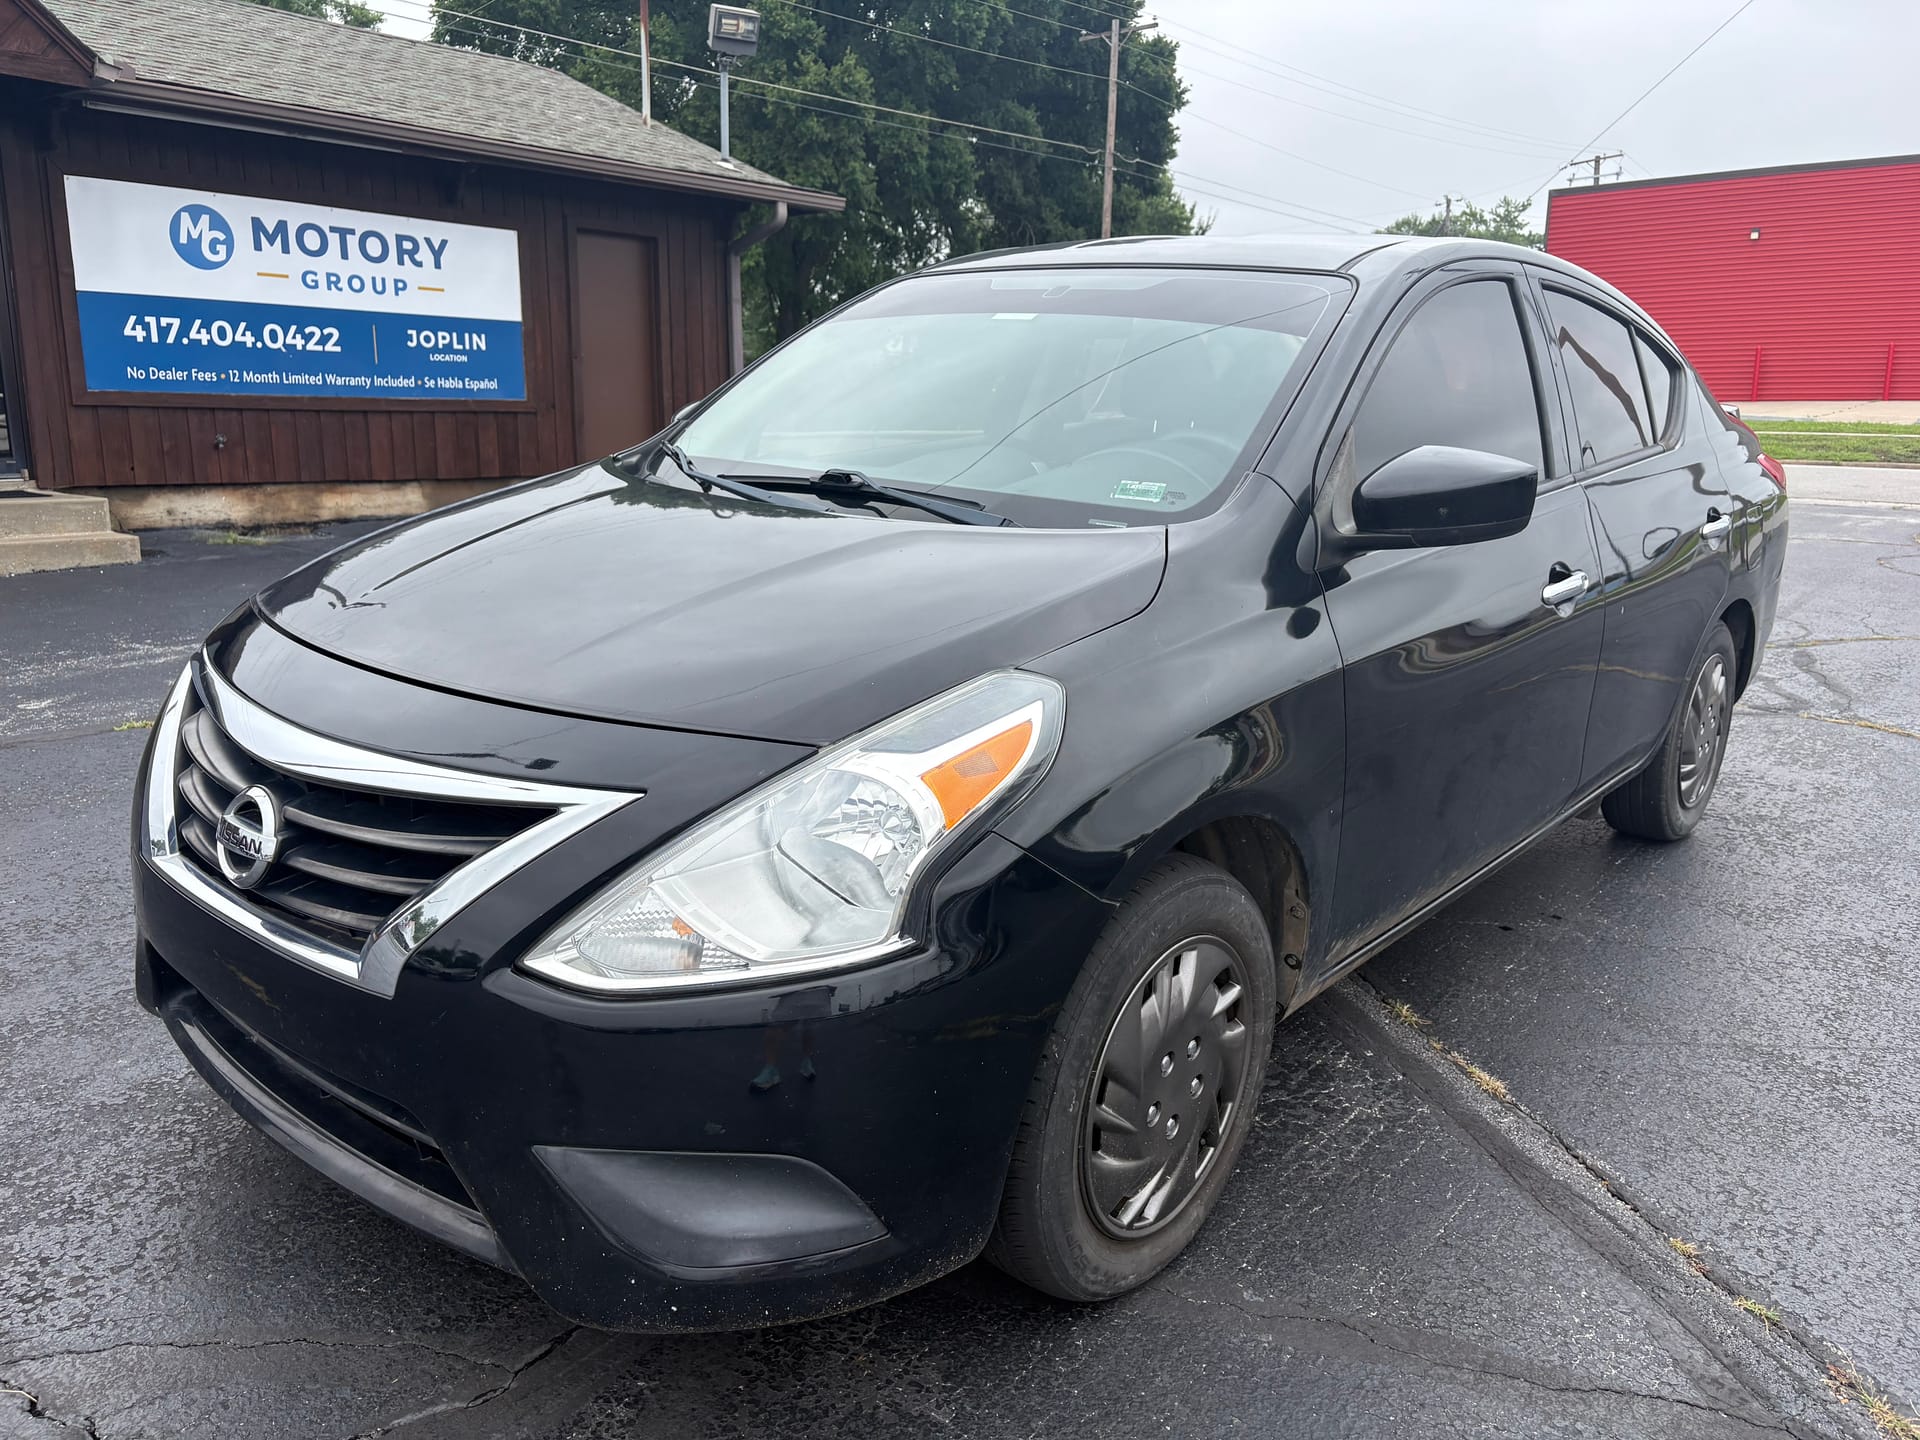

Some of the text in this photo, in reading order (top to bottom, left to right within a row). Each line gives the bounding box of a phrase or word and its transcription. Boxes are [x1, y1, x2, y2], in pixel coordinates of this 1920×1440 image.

[179, 211, 227, 262] MG
[251, 216, 449, 270] MOTORY
[301, 270, 408, 297] GROUP
[123, 315, 342, 352] 417.404.0422
[406, 329, 487, 351] JOPLIN
[429, 353, 468, 362] LOCATION
[126, 366, 498, 392] No Dealer Fees 12 Month Limited Warranty Included Se Habla Español
